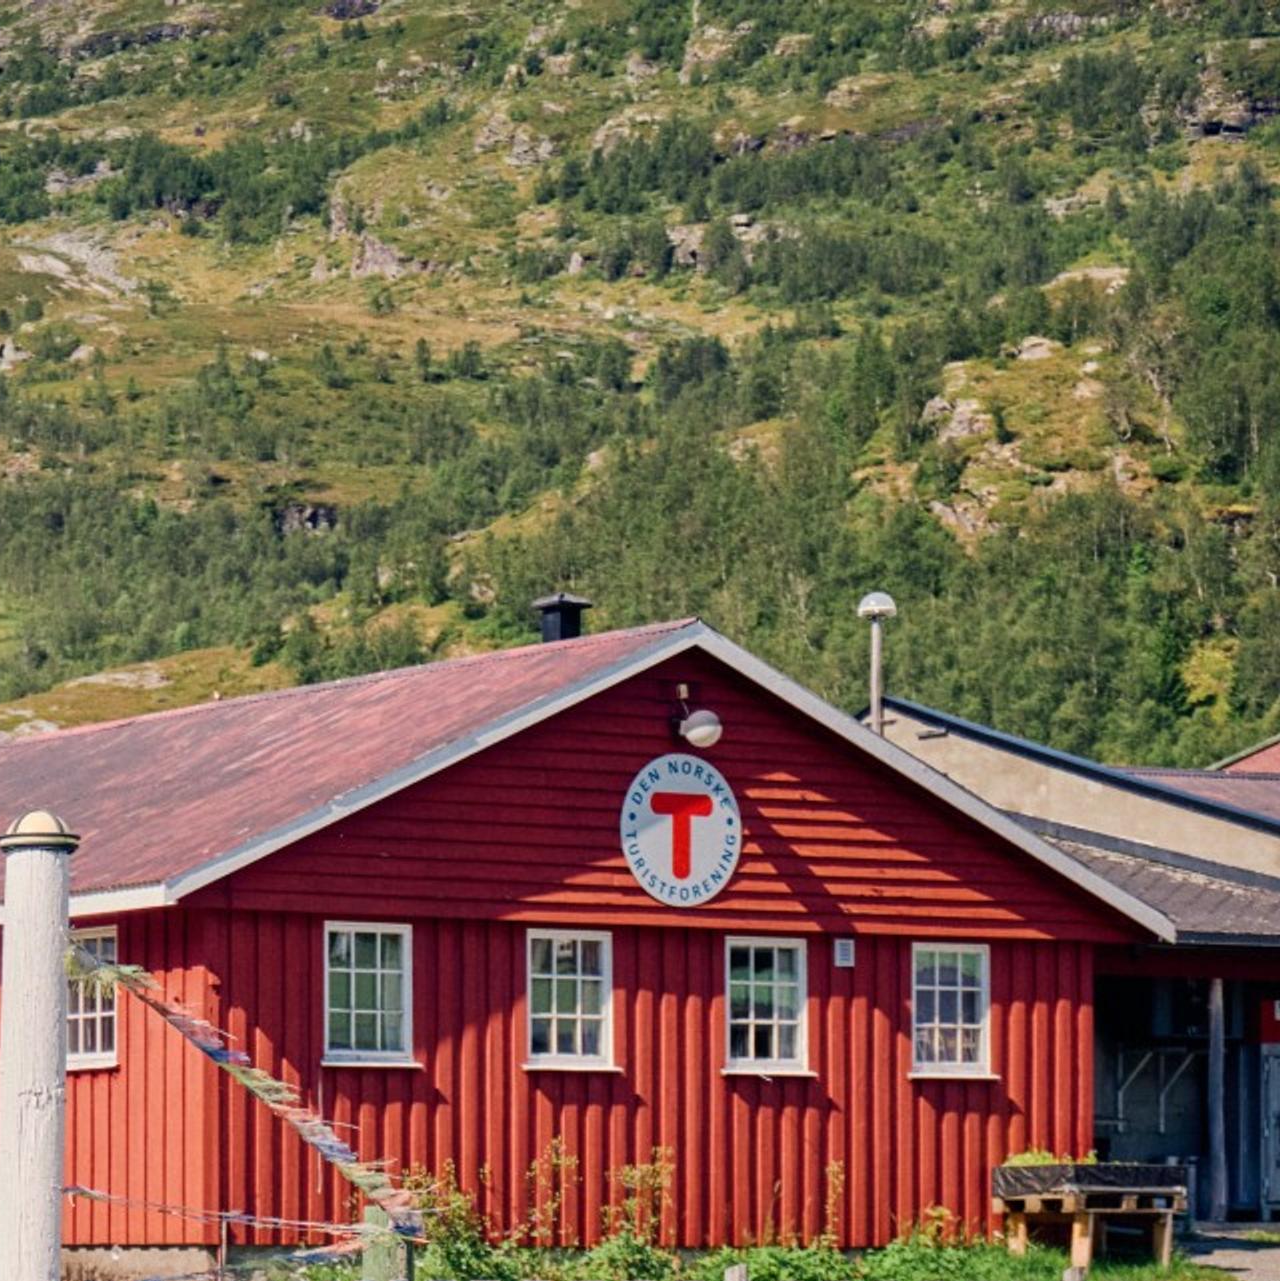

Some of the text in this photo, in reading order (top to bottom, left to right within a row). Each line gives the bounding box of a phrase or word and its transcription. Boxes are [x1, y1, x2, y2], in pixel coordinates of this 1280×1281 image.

[631, 760, 731, 808] DEN NORSKE
[626, 830, 737, 900] TURISTFORENING
[650, 792, 713, 880] T
